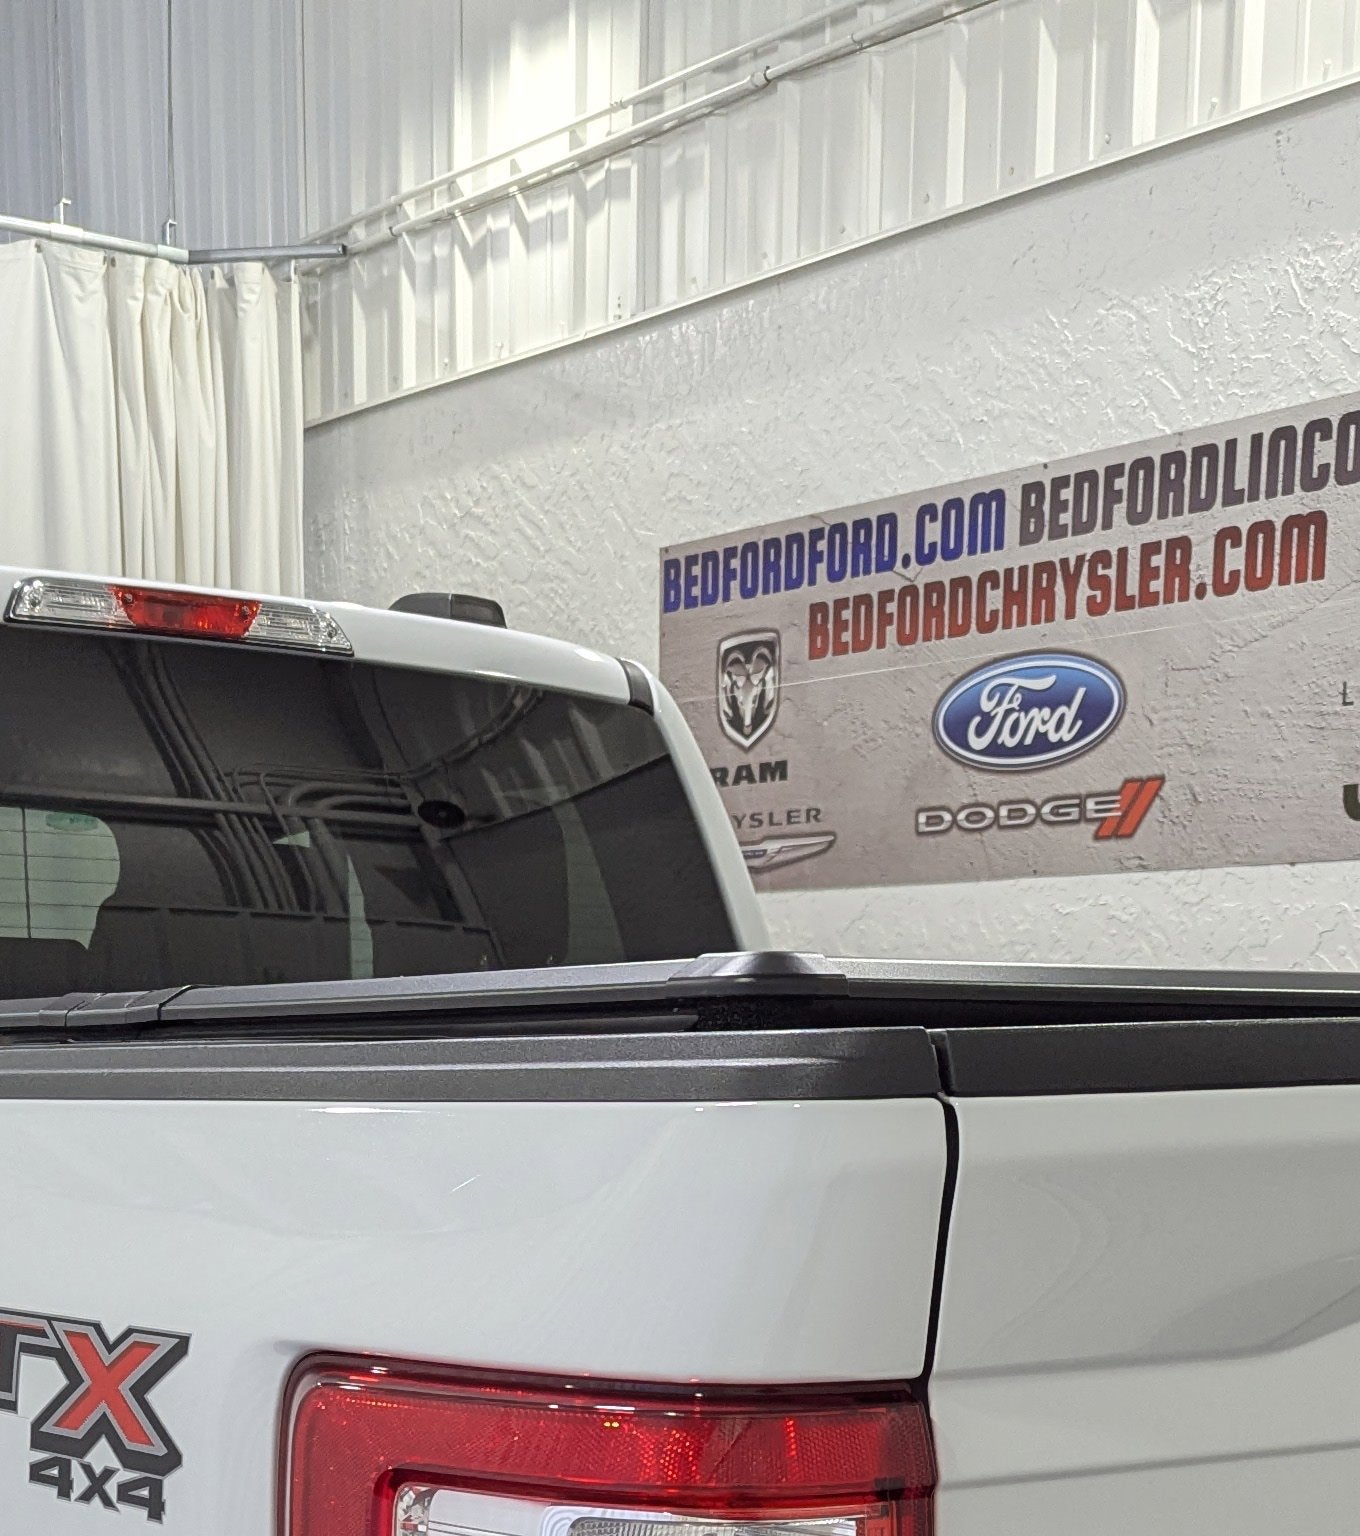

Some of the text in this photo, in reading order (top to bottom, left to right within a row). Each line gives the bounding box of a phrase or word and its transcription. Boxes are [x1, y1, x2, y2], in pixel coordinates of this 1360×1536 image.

[663, 488, 1006, 614] BEDFORDFORD.COM
[808, 509, 1328, 661] BEDFORDCHRYSLER.COM
[967, 674, 1087, 751] Ford
[709, 759, 789, 788] RAM
[730, 807, 822, 829] YSLER
[915, 792, 1123, 836] DODGE
